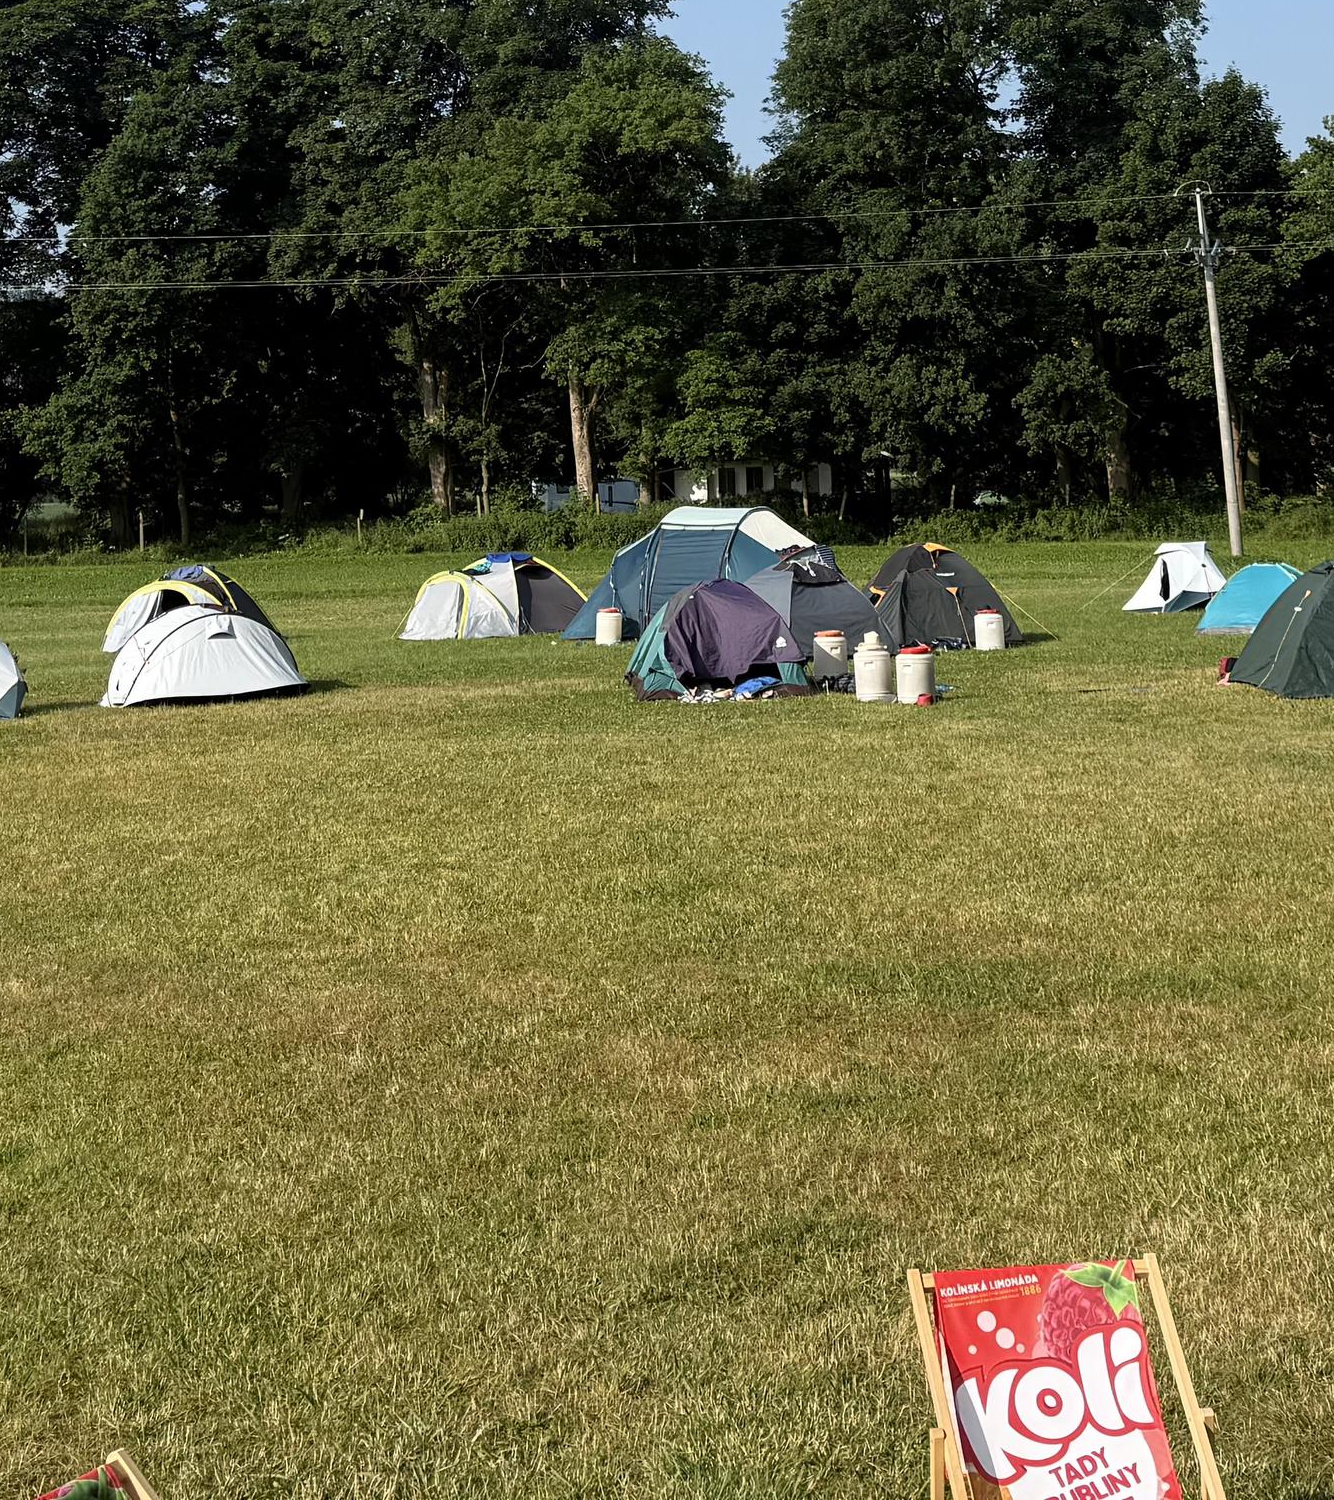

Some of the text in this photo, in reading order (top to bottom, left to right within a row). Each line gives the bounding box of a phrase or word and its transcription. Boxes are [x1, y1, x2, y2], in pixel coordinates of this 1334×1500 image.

[940, 1274, 1039, 1297] KOLÍNSKÁ LIMONÁDA
[1020, 1285, 1041, 1296] 1886
[1043, 1462, 1142, 1500] BLINY
[1048, 1446, 1110, 1488] TADY
